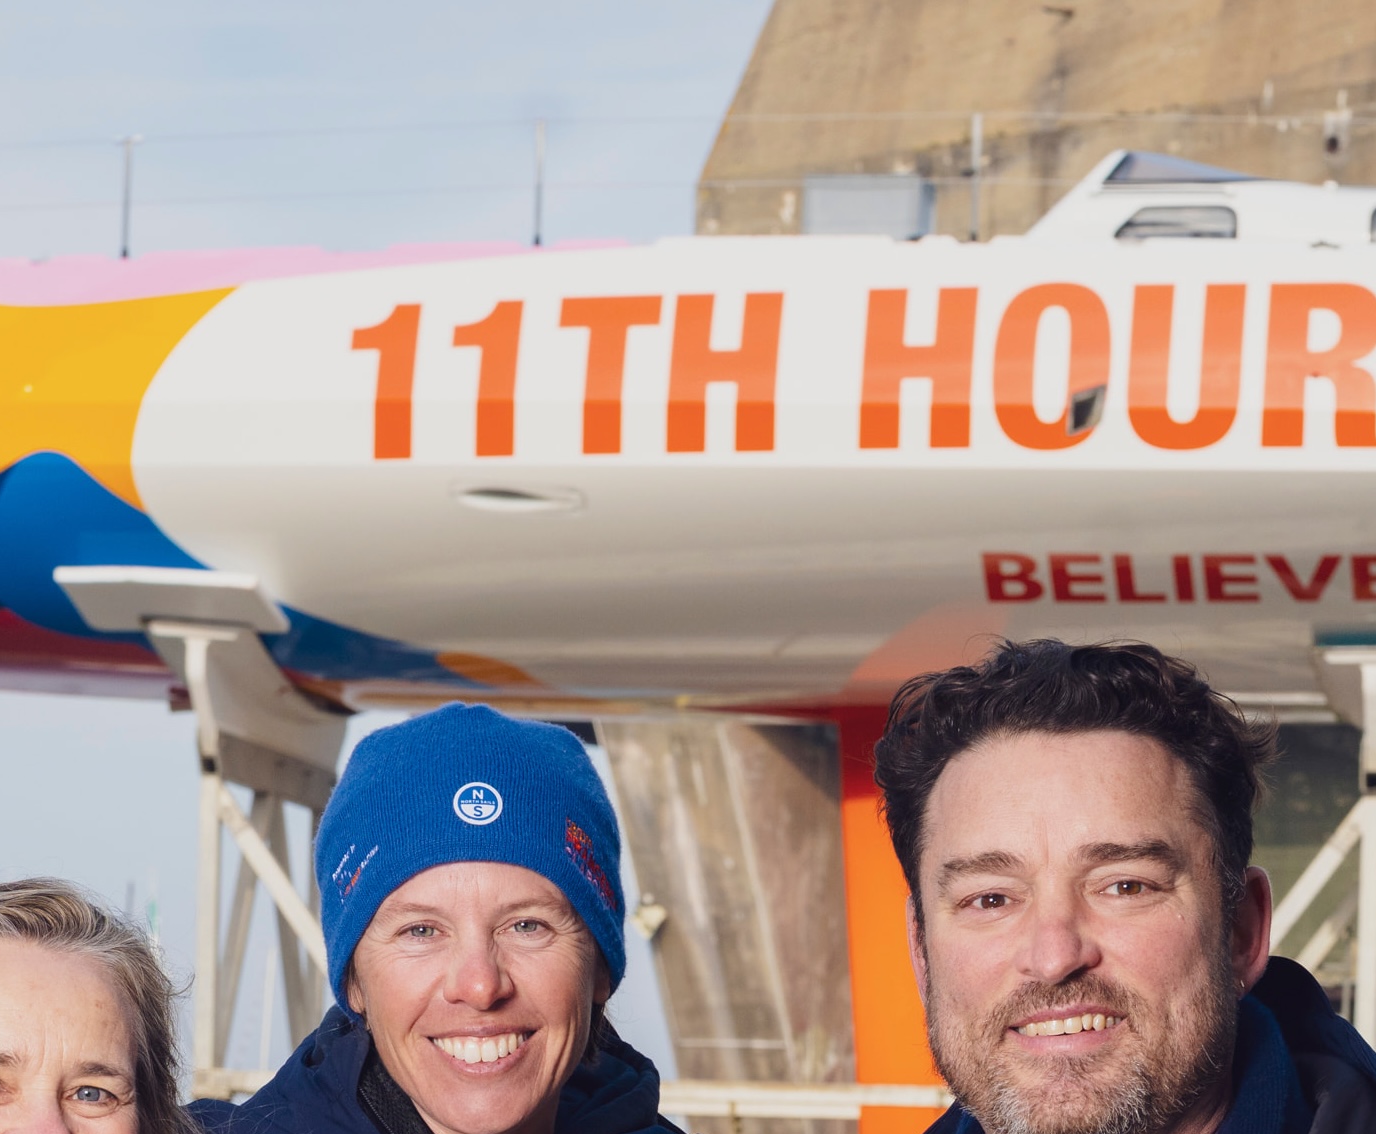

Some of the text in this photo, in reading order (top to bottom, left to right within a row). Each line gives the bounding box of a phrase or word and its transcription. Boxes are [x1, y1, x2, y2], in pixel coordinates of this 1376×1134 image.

[351, 292, 785, 460] 11TH
[472, 789, 484, 800] N
[473, 805, 483, 817] S
